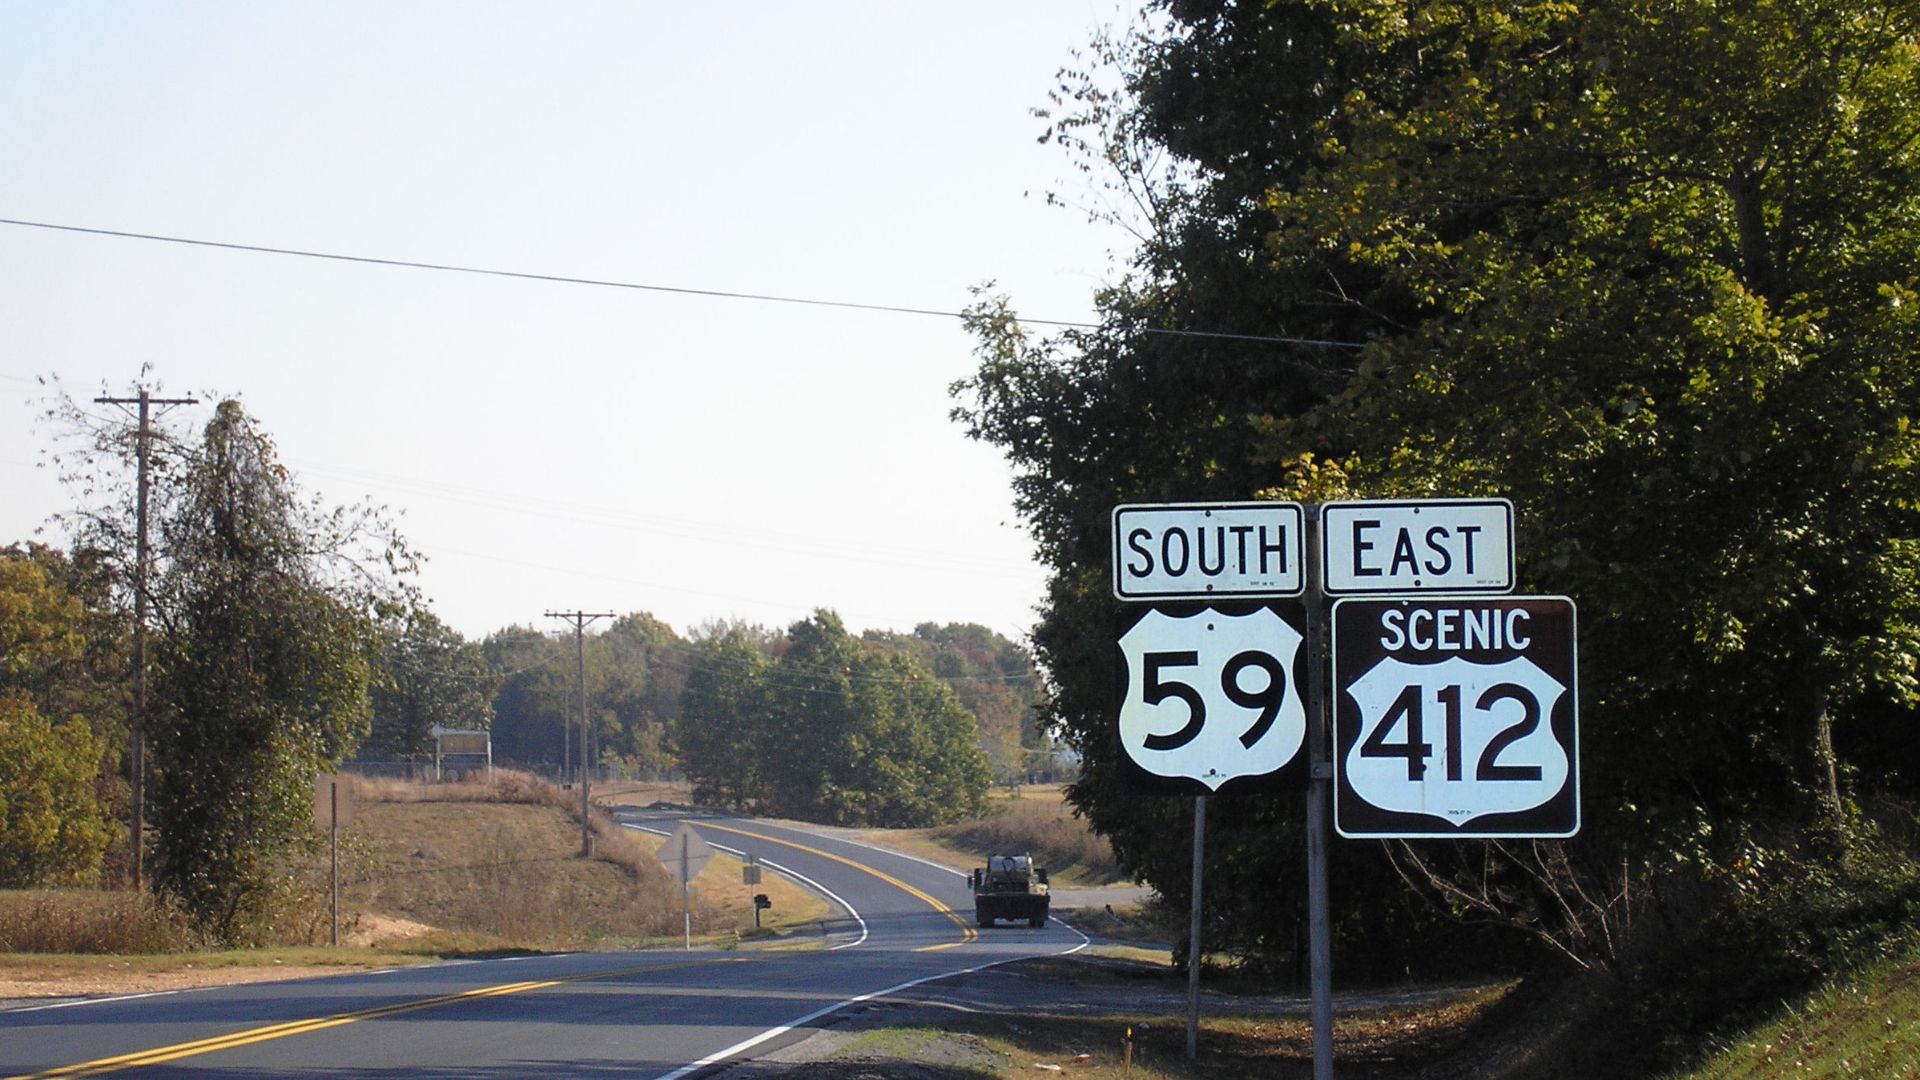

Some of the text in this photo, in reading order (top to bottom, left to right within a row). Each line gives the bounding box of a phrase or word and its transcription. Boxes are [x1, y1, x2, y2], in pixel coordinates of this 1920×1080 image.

[1127, 525, 1288, 578] SOUTH
[1353, 520, 1482, 576] EAST
[1381, 609, 1531, 651] SCENIC
[1142, 650, 1286, 750] 59
[1360, 683, 1542, 782] 412
